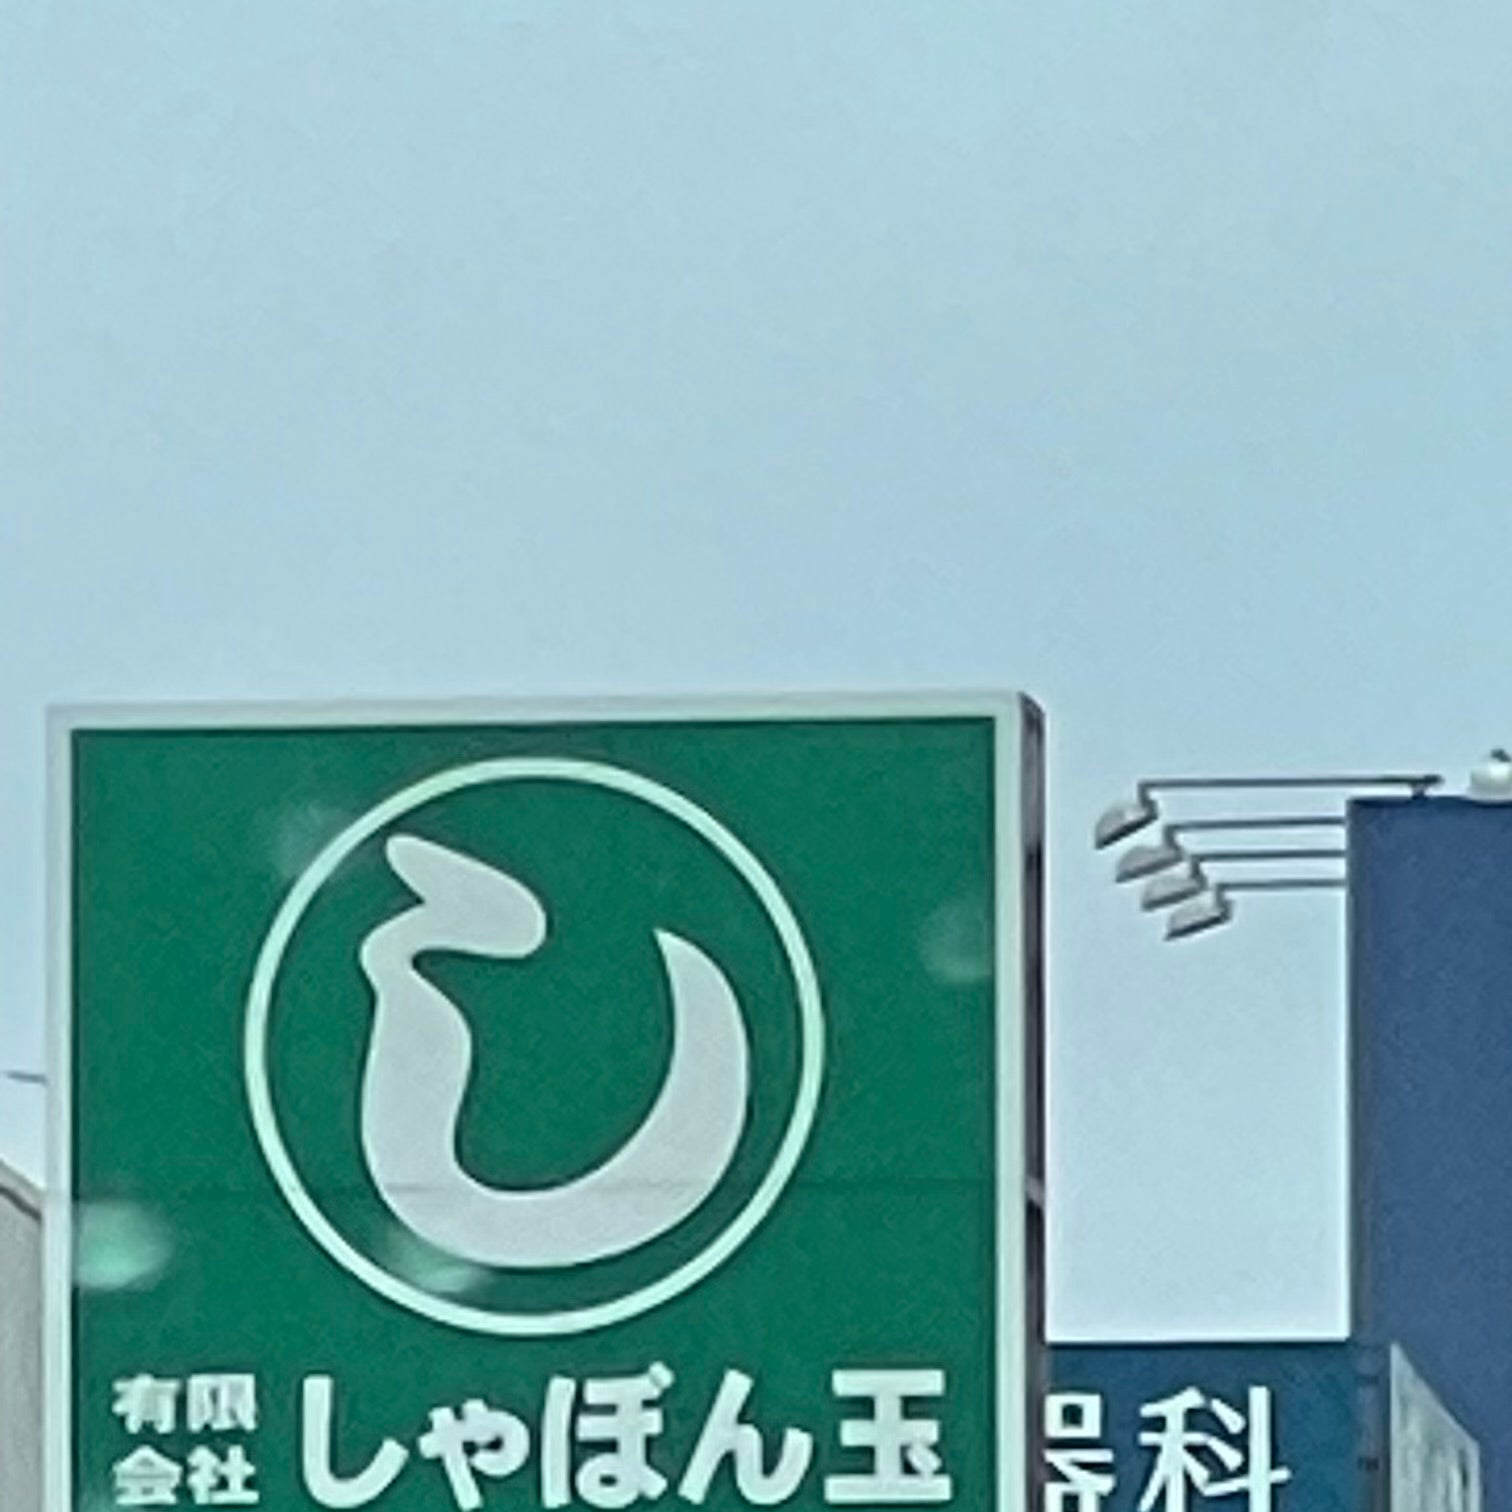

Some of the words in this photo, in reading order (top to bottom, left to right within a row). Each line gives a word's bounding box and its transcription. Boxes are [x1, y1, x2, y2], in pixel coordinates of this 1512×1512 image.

[112, 1445, 260, 1507] 会社
[302, 1361, 953, 1512] しゃぼん玉
